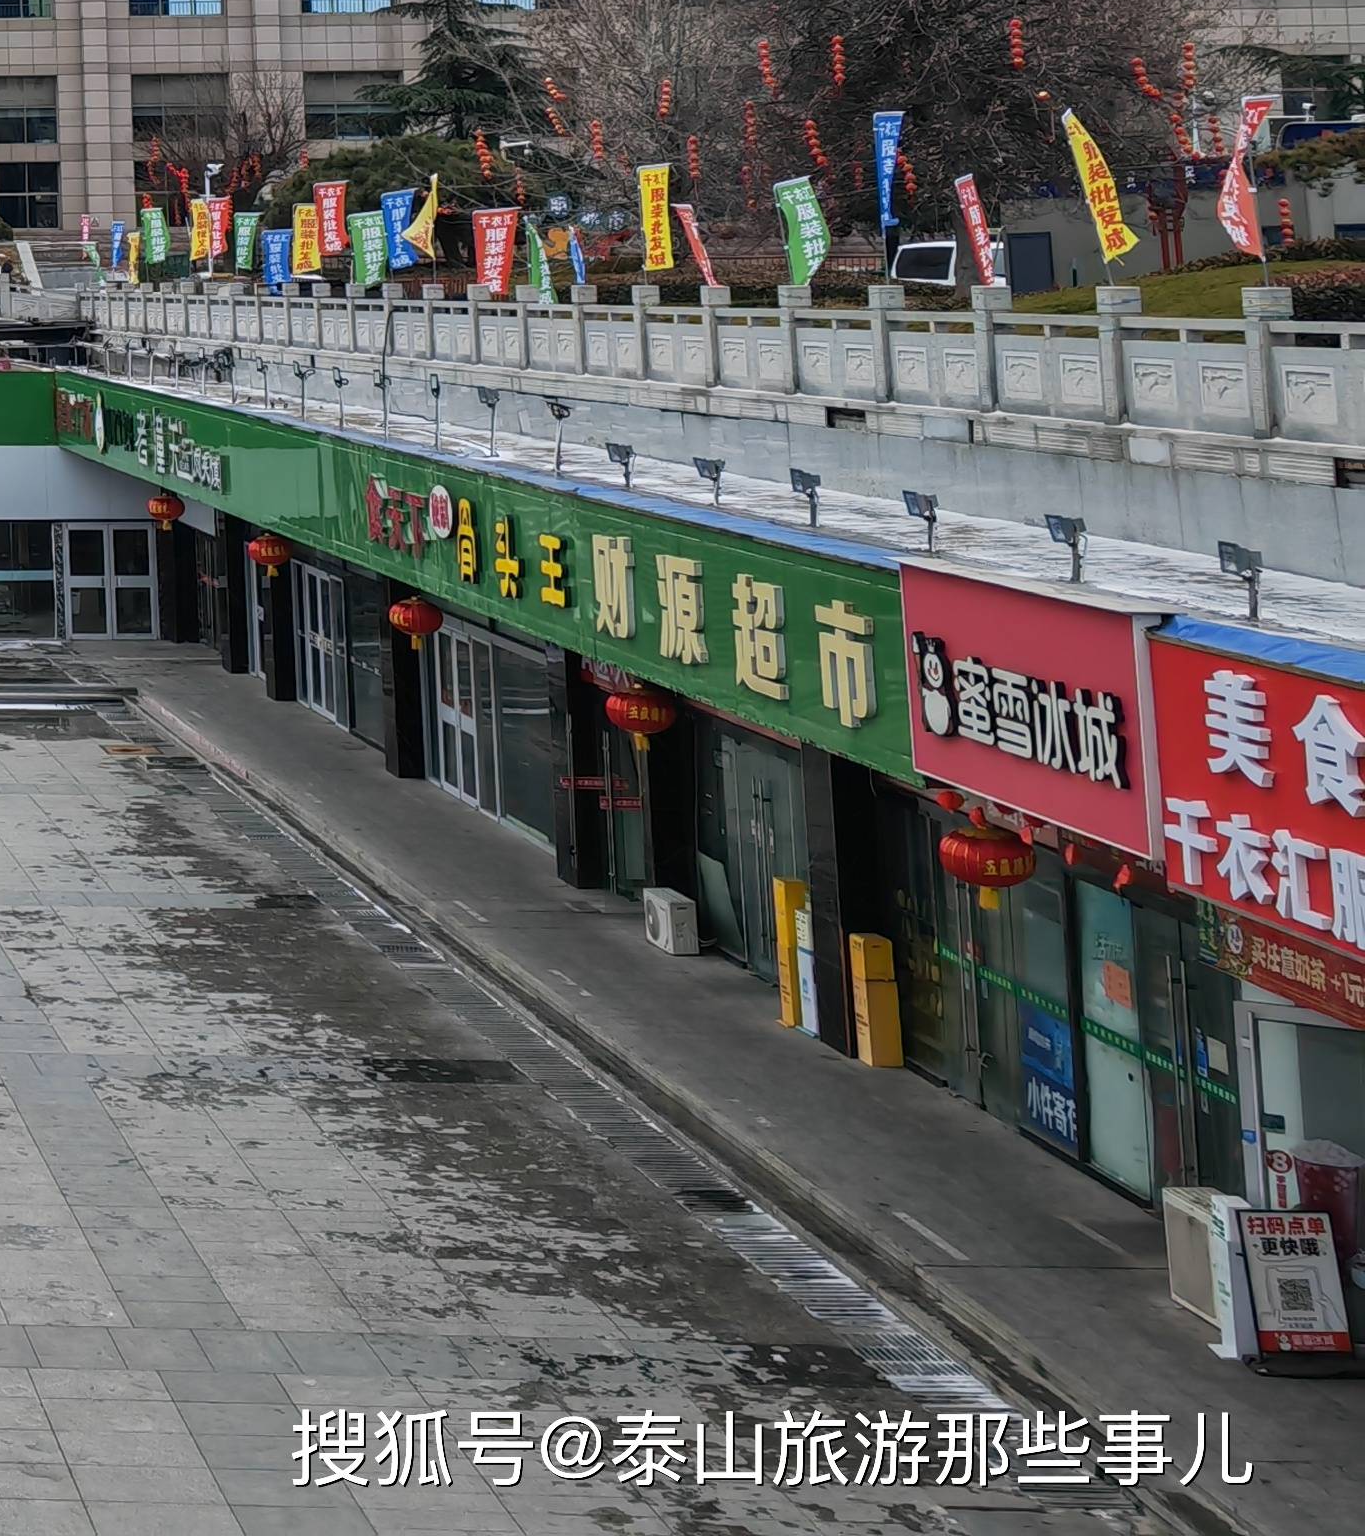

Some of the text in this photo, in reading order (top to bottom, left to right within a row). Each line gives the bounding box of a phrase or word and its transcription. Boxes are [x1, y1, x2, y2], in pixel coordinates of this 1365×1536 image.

[478, 214, 514, 229] 千衣汇
[1082, 139, 1128, 252] 服装批发城
[794, 204, 827, 286] 服装批发
[457, 497, 566, 608] 骨头王
[592, 534, 876, 728] 财源超市
[952, 657, 1124, 789] 蜜雪冰城
[1204, 670, 1365, 817] 美食
[1251, 935, 1365, 1008] 买任意奶茶+1元
[1247, 1216, 1327, 1236] 扫码点单
[1260, 1237, 1321, 1257] 更快哦
